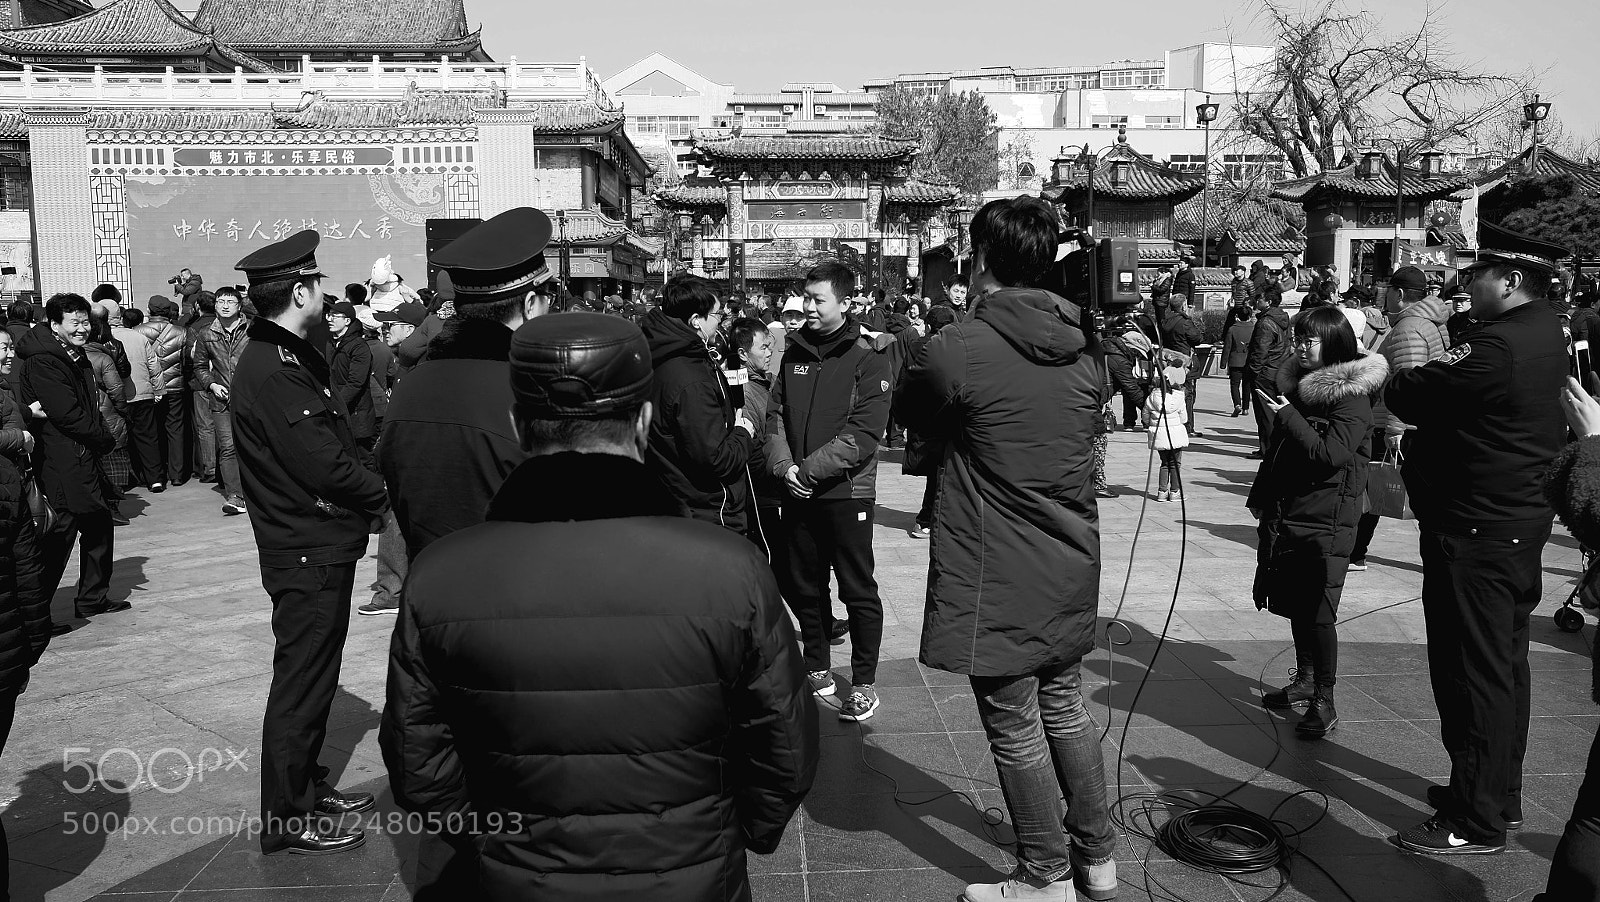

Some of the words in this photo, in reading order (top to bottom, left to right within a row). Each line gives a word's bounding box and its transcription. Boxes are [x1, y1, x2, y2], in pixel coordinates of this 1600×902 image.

[209, 149, 356, 165] 魅力市北·乐享民俗
[172, 215, 394, 242] 中华奇人绝技达人秀
